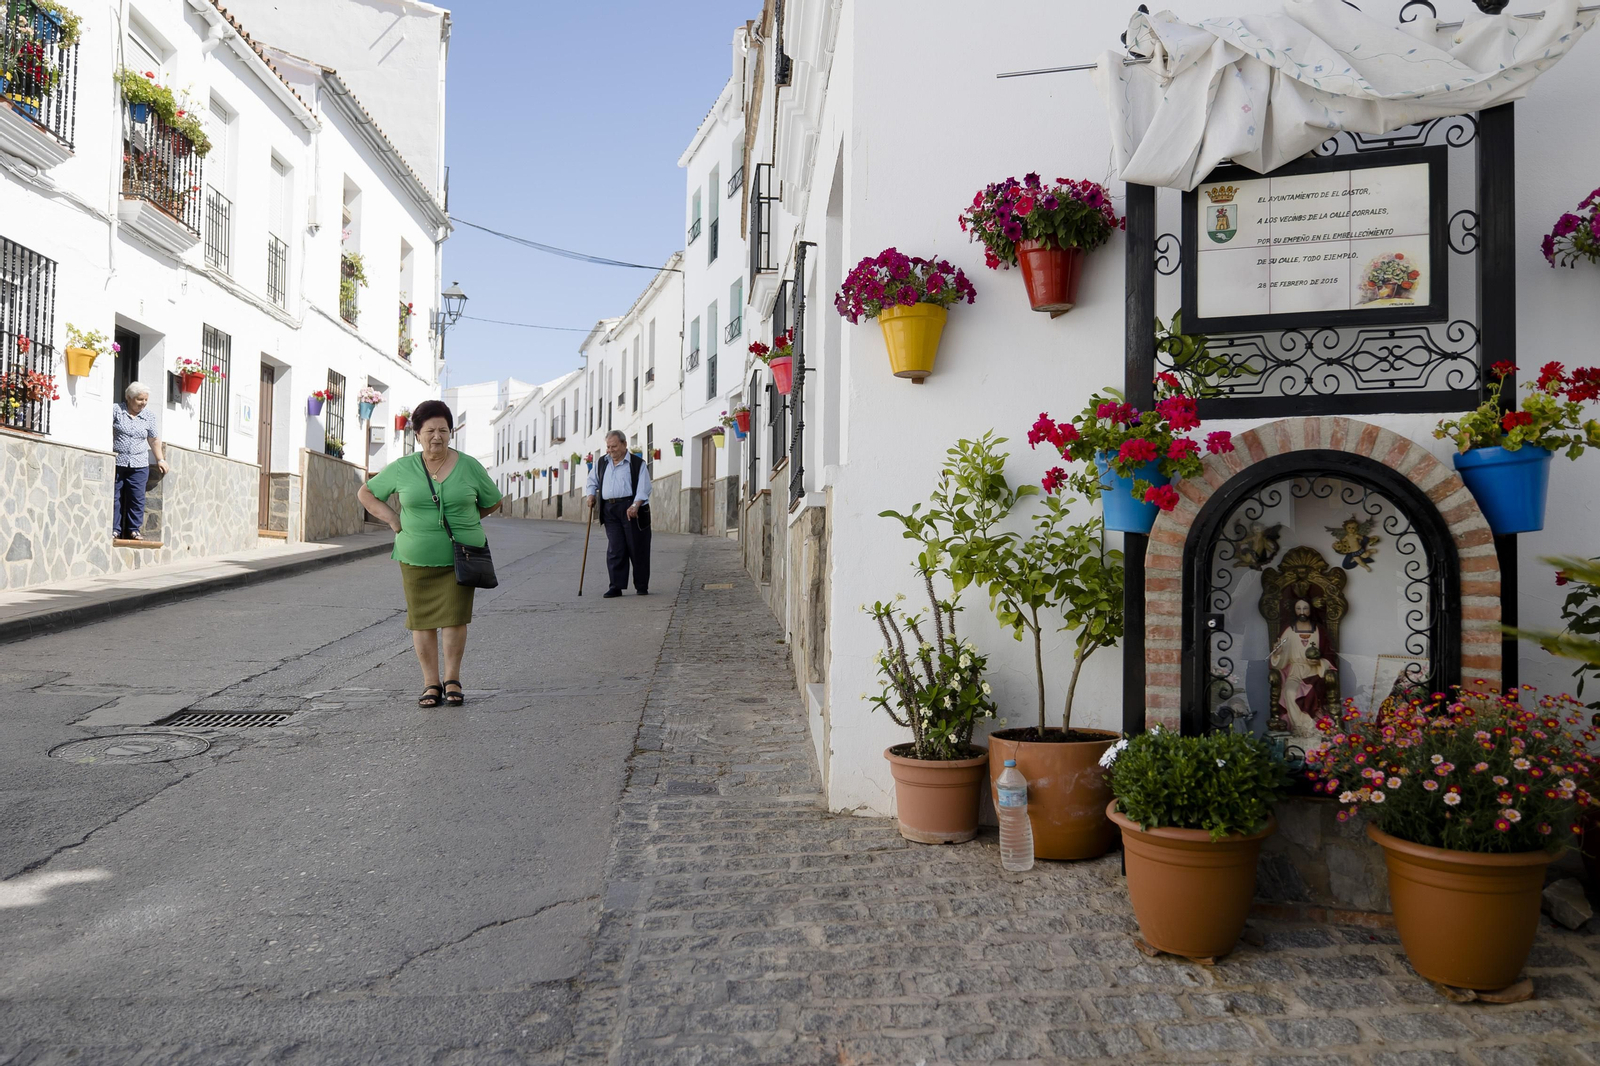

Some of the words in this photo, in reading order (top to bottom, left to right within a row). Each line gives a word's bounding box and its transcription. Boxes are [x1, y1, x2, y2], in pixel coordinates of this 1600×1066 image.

[1268, 191, 1319, 202] AYUNTAMIENTO
[1342, 188, 1371, 196] GASTOR,
[1280, 213, 1306, 222] VECINOS
[1352, 208, 1389, 216] CORRALES,
[1282, 234, 1310, 243] EMPEÑO
[1332, 228, 1394, 239] EMBELLECIMIENTO
[1323, 252, 1359, 260] EJEMPLO.
